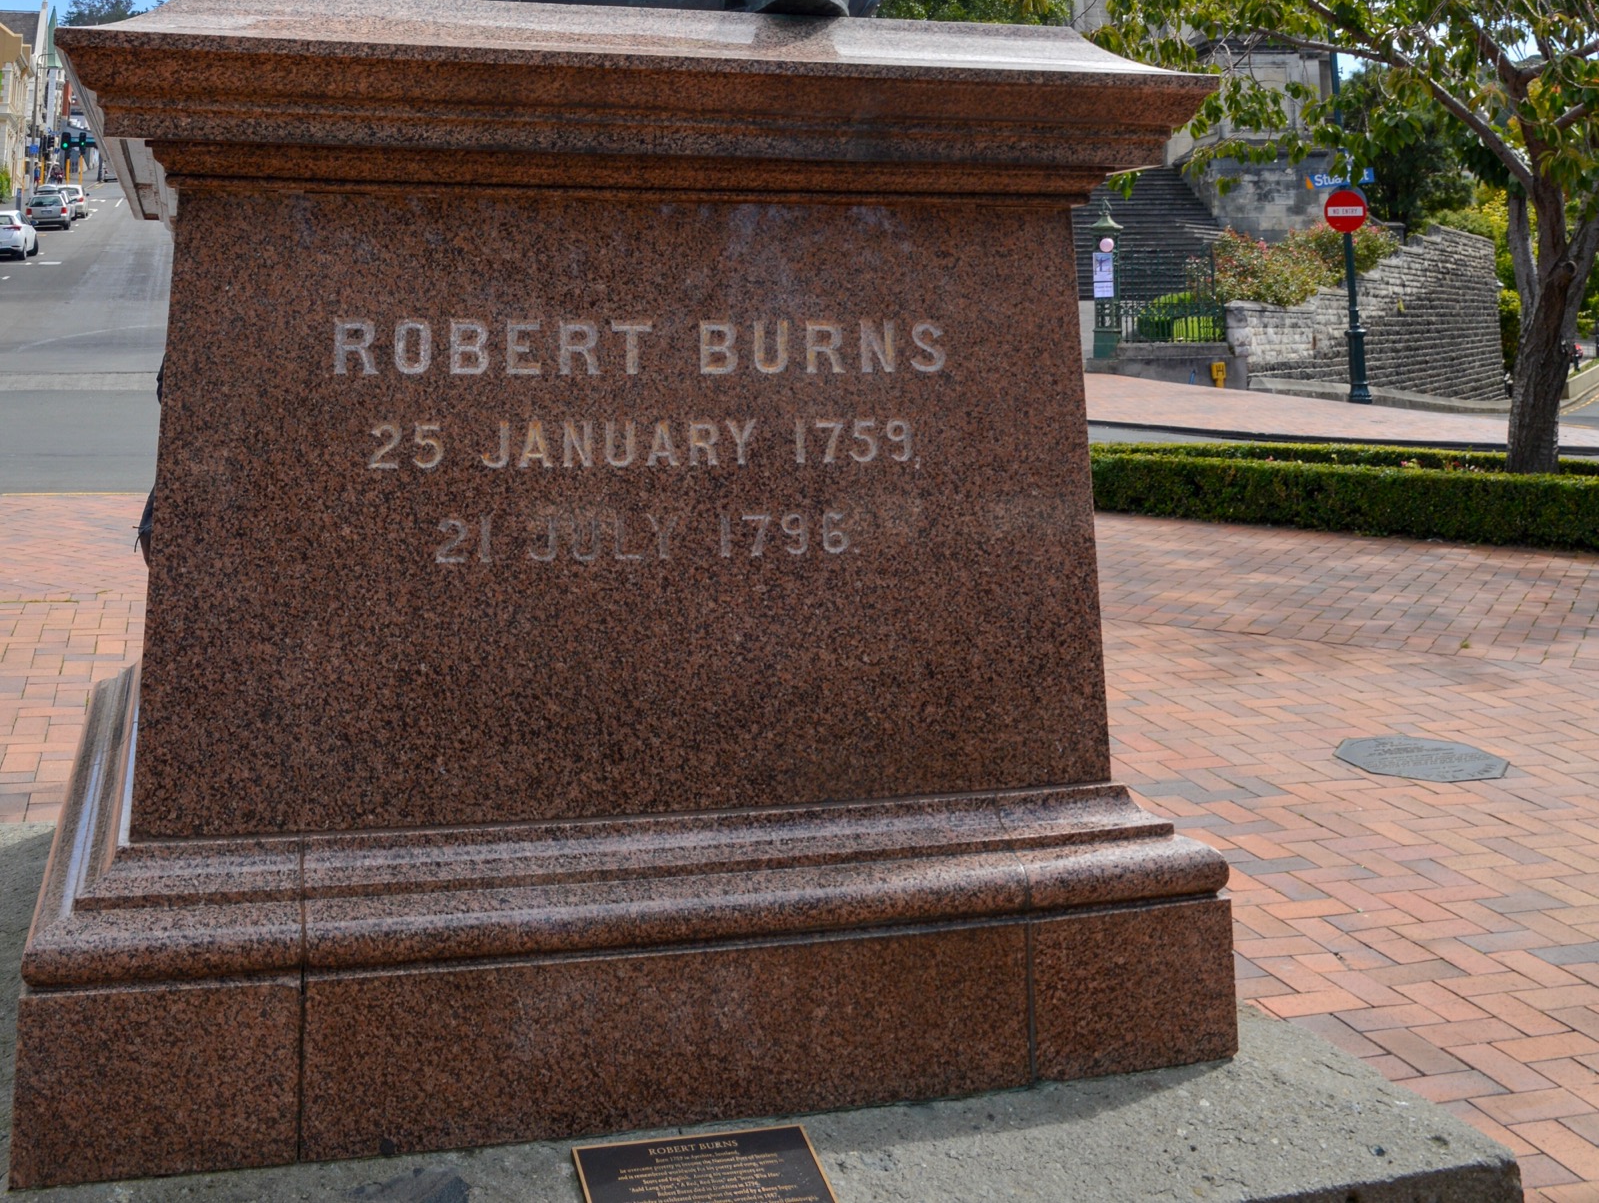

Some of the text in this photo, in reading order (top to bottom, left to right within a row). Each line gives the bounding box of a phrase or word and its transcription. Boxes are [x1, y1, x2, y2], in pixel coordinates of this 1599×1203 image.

[331, 316, 947, 376] ROBERT BURNS
[367, 422, 446, 470] 25
[480, 417, 758, 468] JANUARY
[434, 515, 493, 565] 21
[527, 510, 679, 563] JULY
[648, 1139, 738, 1156] ROBERT BURNS
